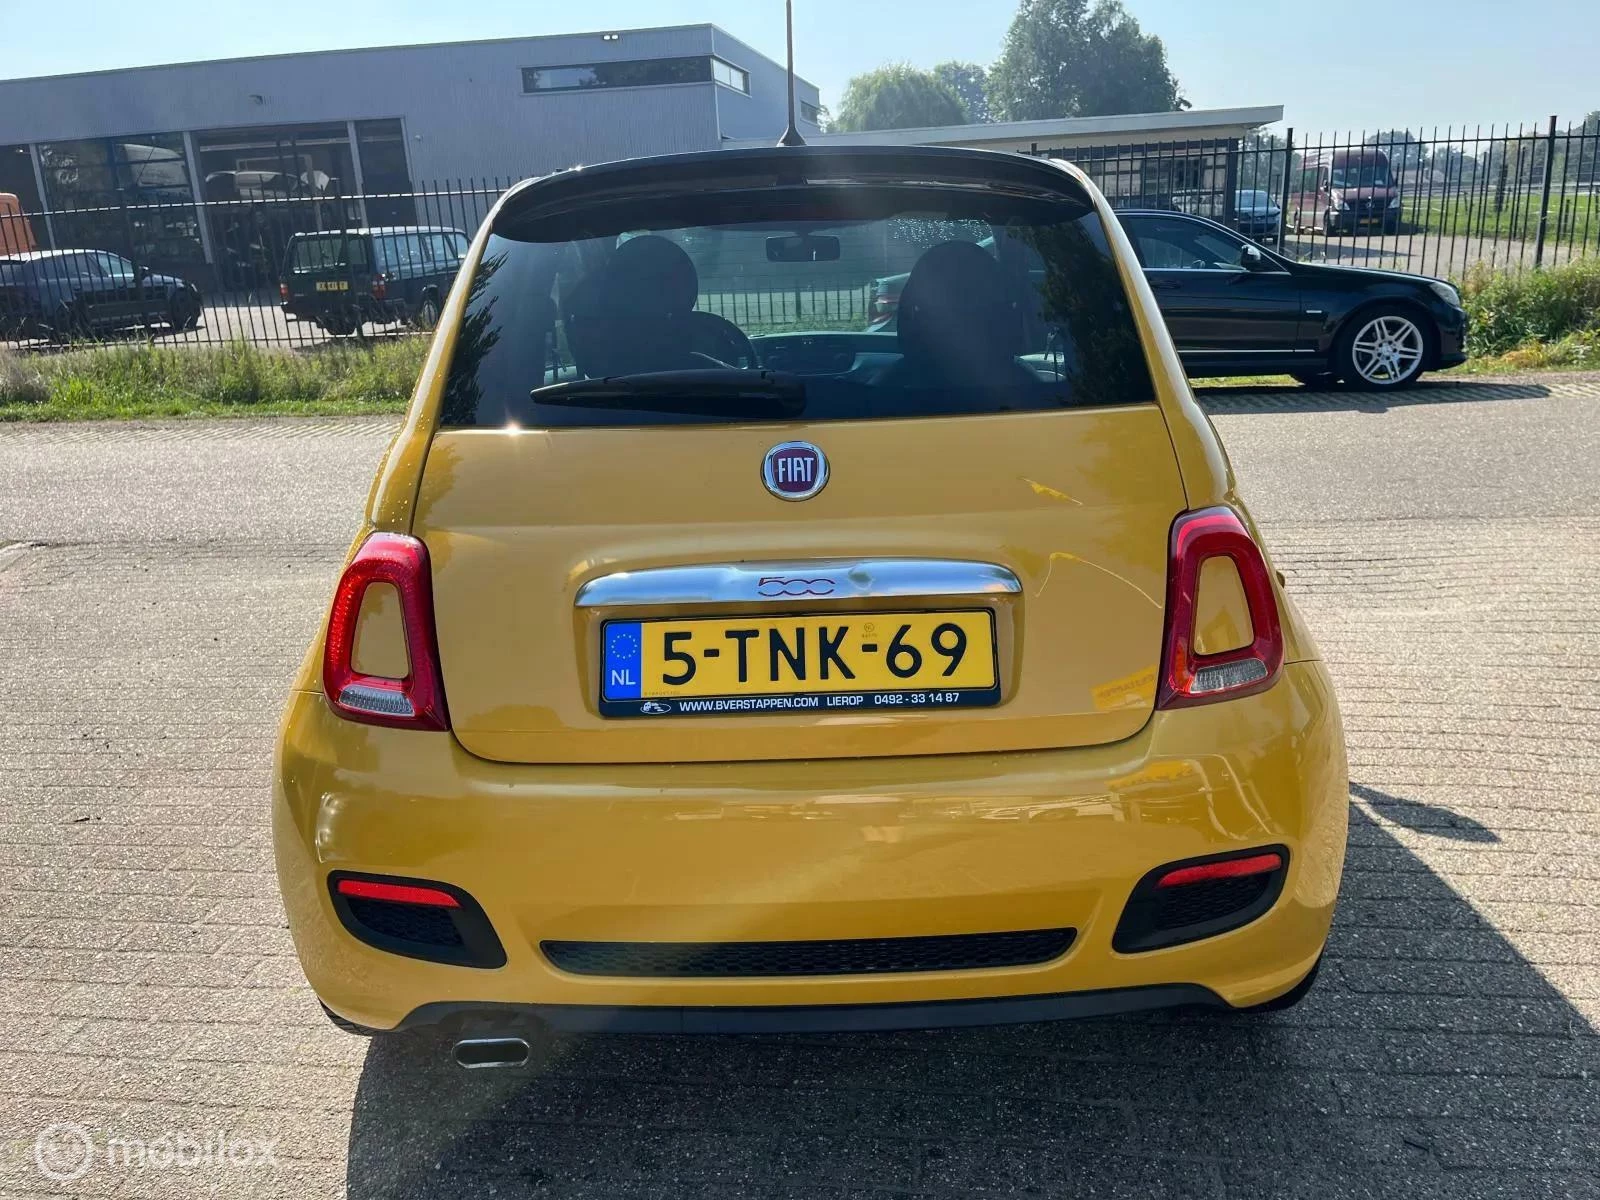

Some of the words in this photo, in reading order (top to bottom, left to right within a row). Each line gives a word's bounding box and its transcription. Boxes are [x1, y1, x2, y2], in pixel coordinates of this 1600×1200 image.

[778, 457, 815, 482] FIAT
[758, 576, 835, 597] 500
[662, 622, 967, 686] 5-TNK-69
[611, 669, 636, 686] NL
[679, 696, 819, 711] WWW.BVERSTAPPEN.COM
[826, 695, 864, 706] LIEROP
[874, 694, 904, 705] 0492
[911, 693, 926, 704] 33
[928, 693, 943, 703] 14
[945, 692, 960, 702] 87
